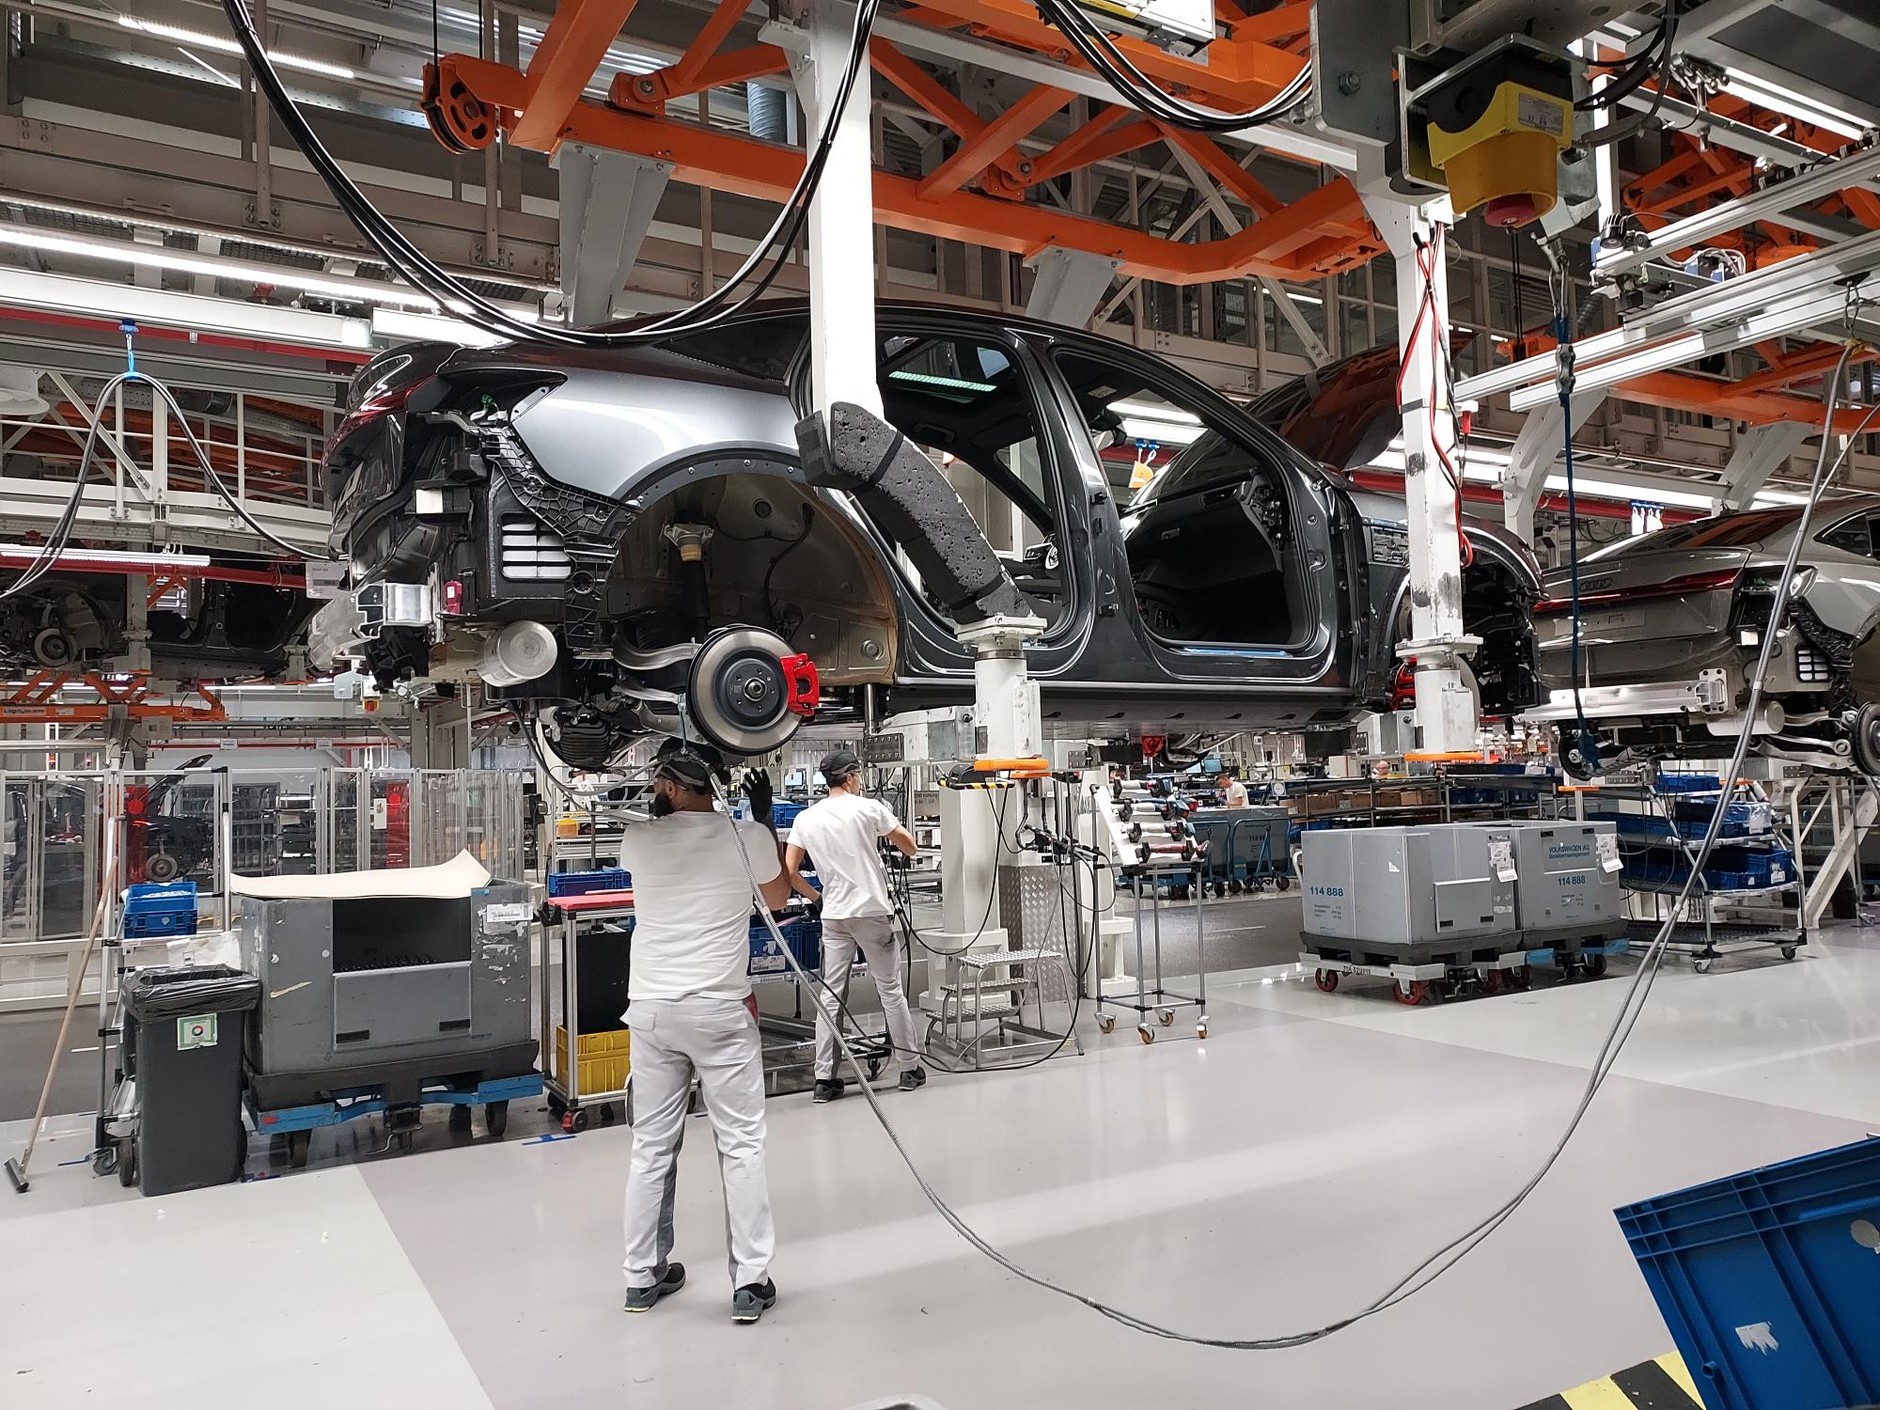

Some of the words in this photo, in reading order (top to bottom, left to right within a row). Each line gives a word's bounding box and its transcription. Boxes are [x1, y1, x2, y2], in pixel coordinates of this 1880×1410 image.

[1583, 844, 1590, 852] AG
[1558, 876, 1571, 886] 114
[1572, 875, 1586, 885] 888
[1310, 886, 1325, 895] 114
[1326, 887, 1344, 897] 888
